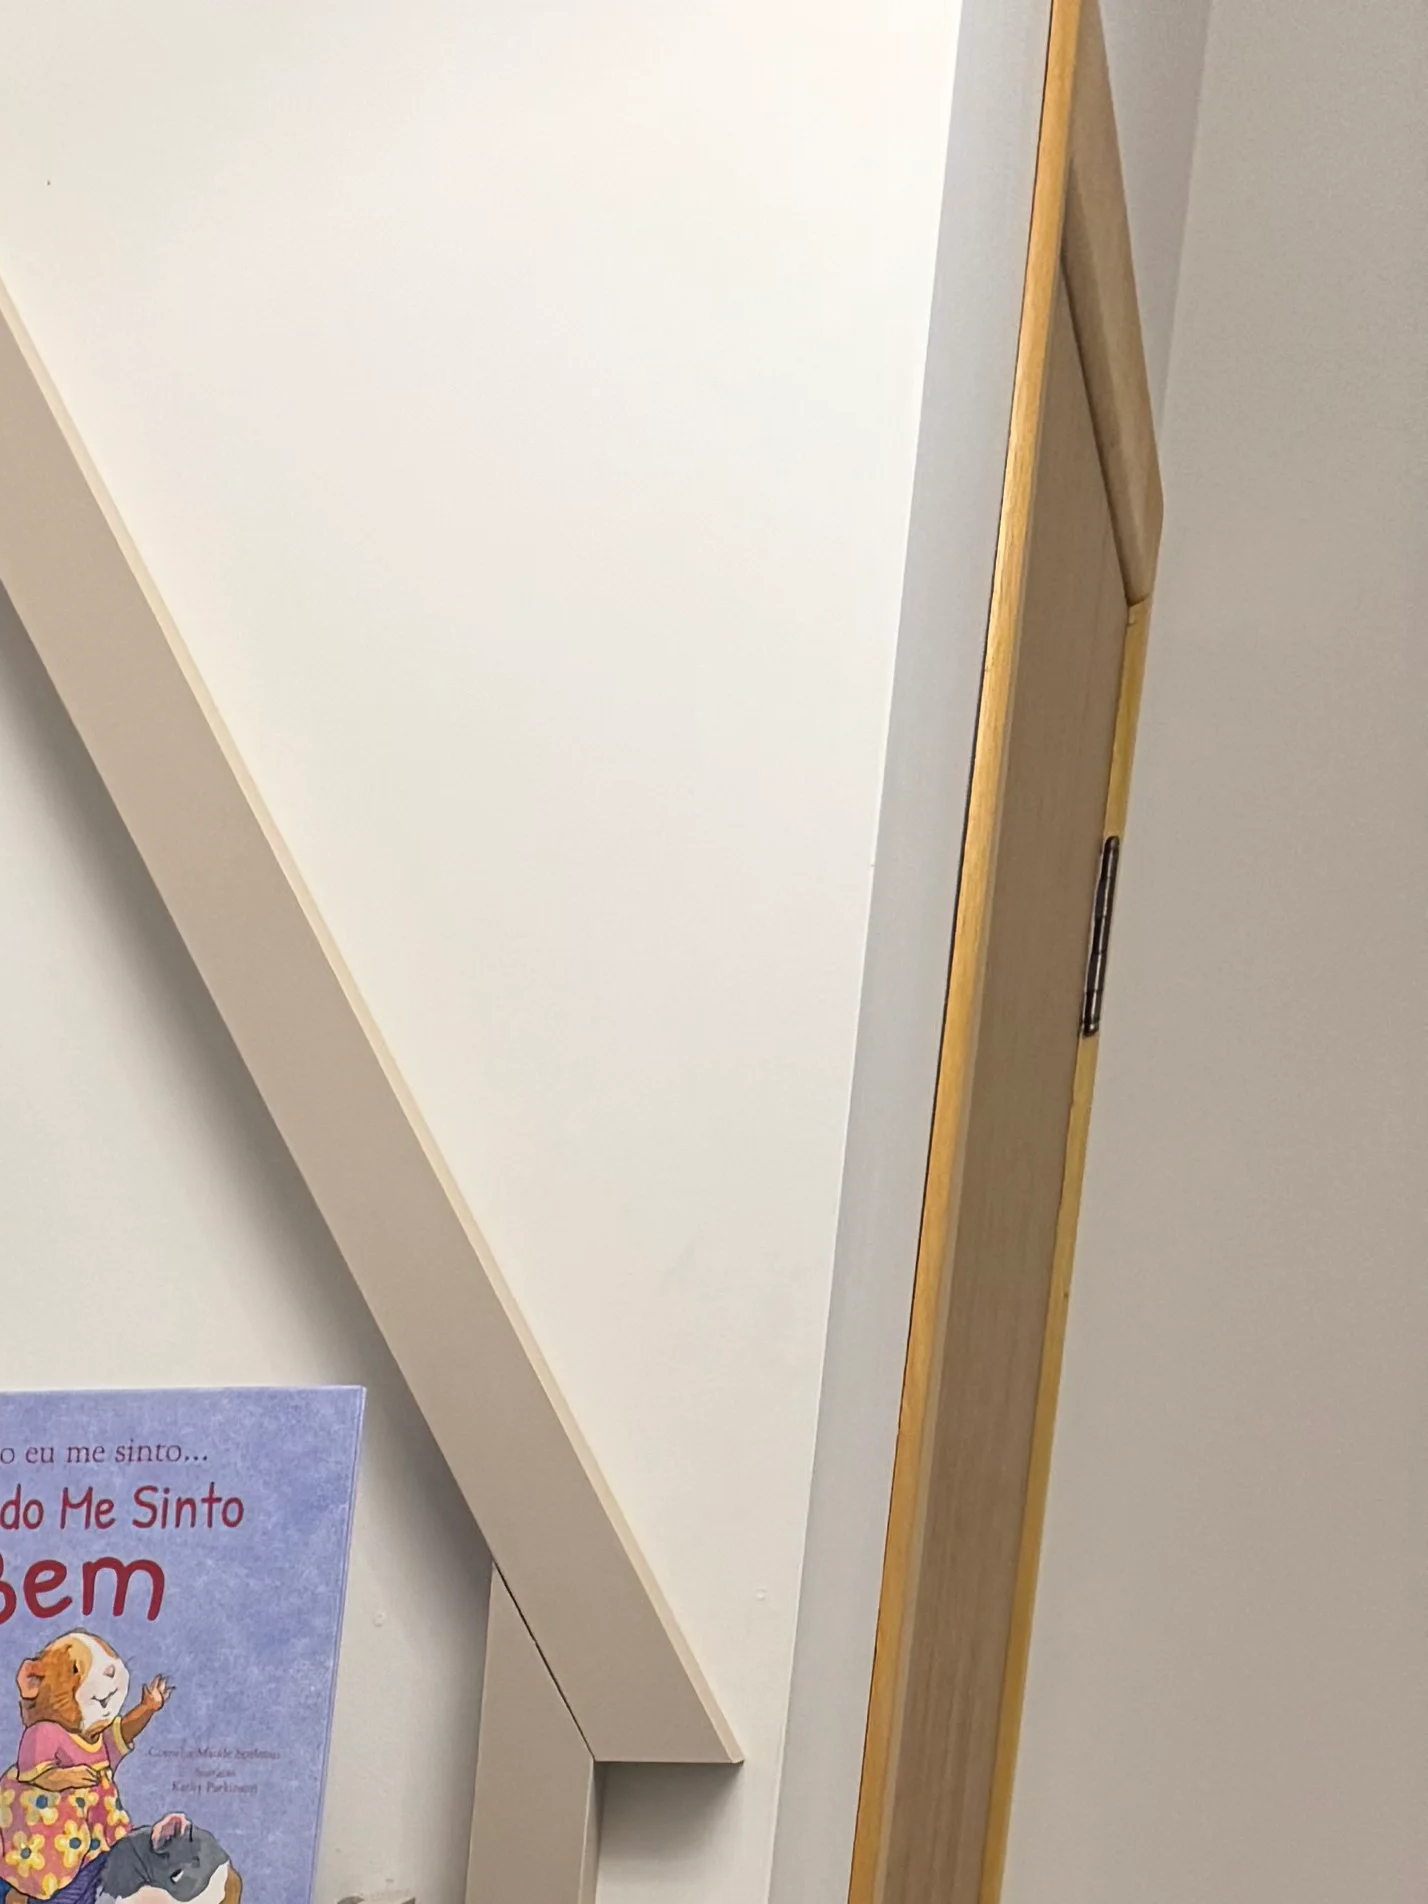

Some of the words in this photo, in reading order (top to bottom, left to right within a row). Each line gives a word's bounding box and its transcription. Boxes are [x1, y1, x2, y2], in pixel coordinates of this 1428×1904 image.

[25, 1445, 55, 1464] eu
[65, 1444, 106, 1463] me
[114, 1439, 209, 1464] sinto...
[60, 1486, 115, 1530] Me
[132, 1481, 245, 1530] Sinto
